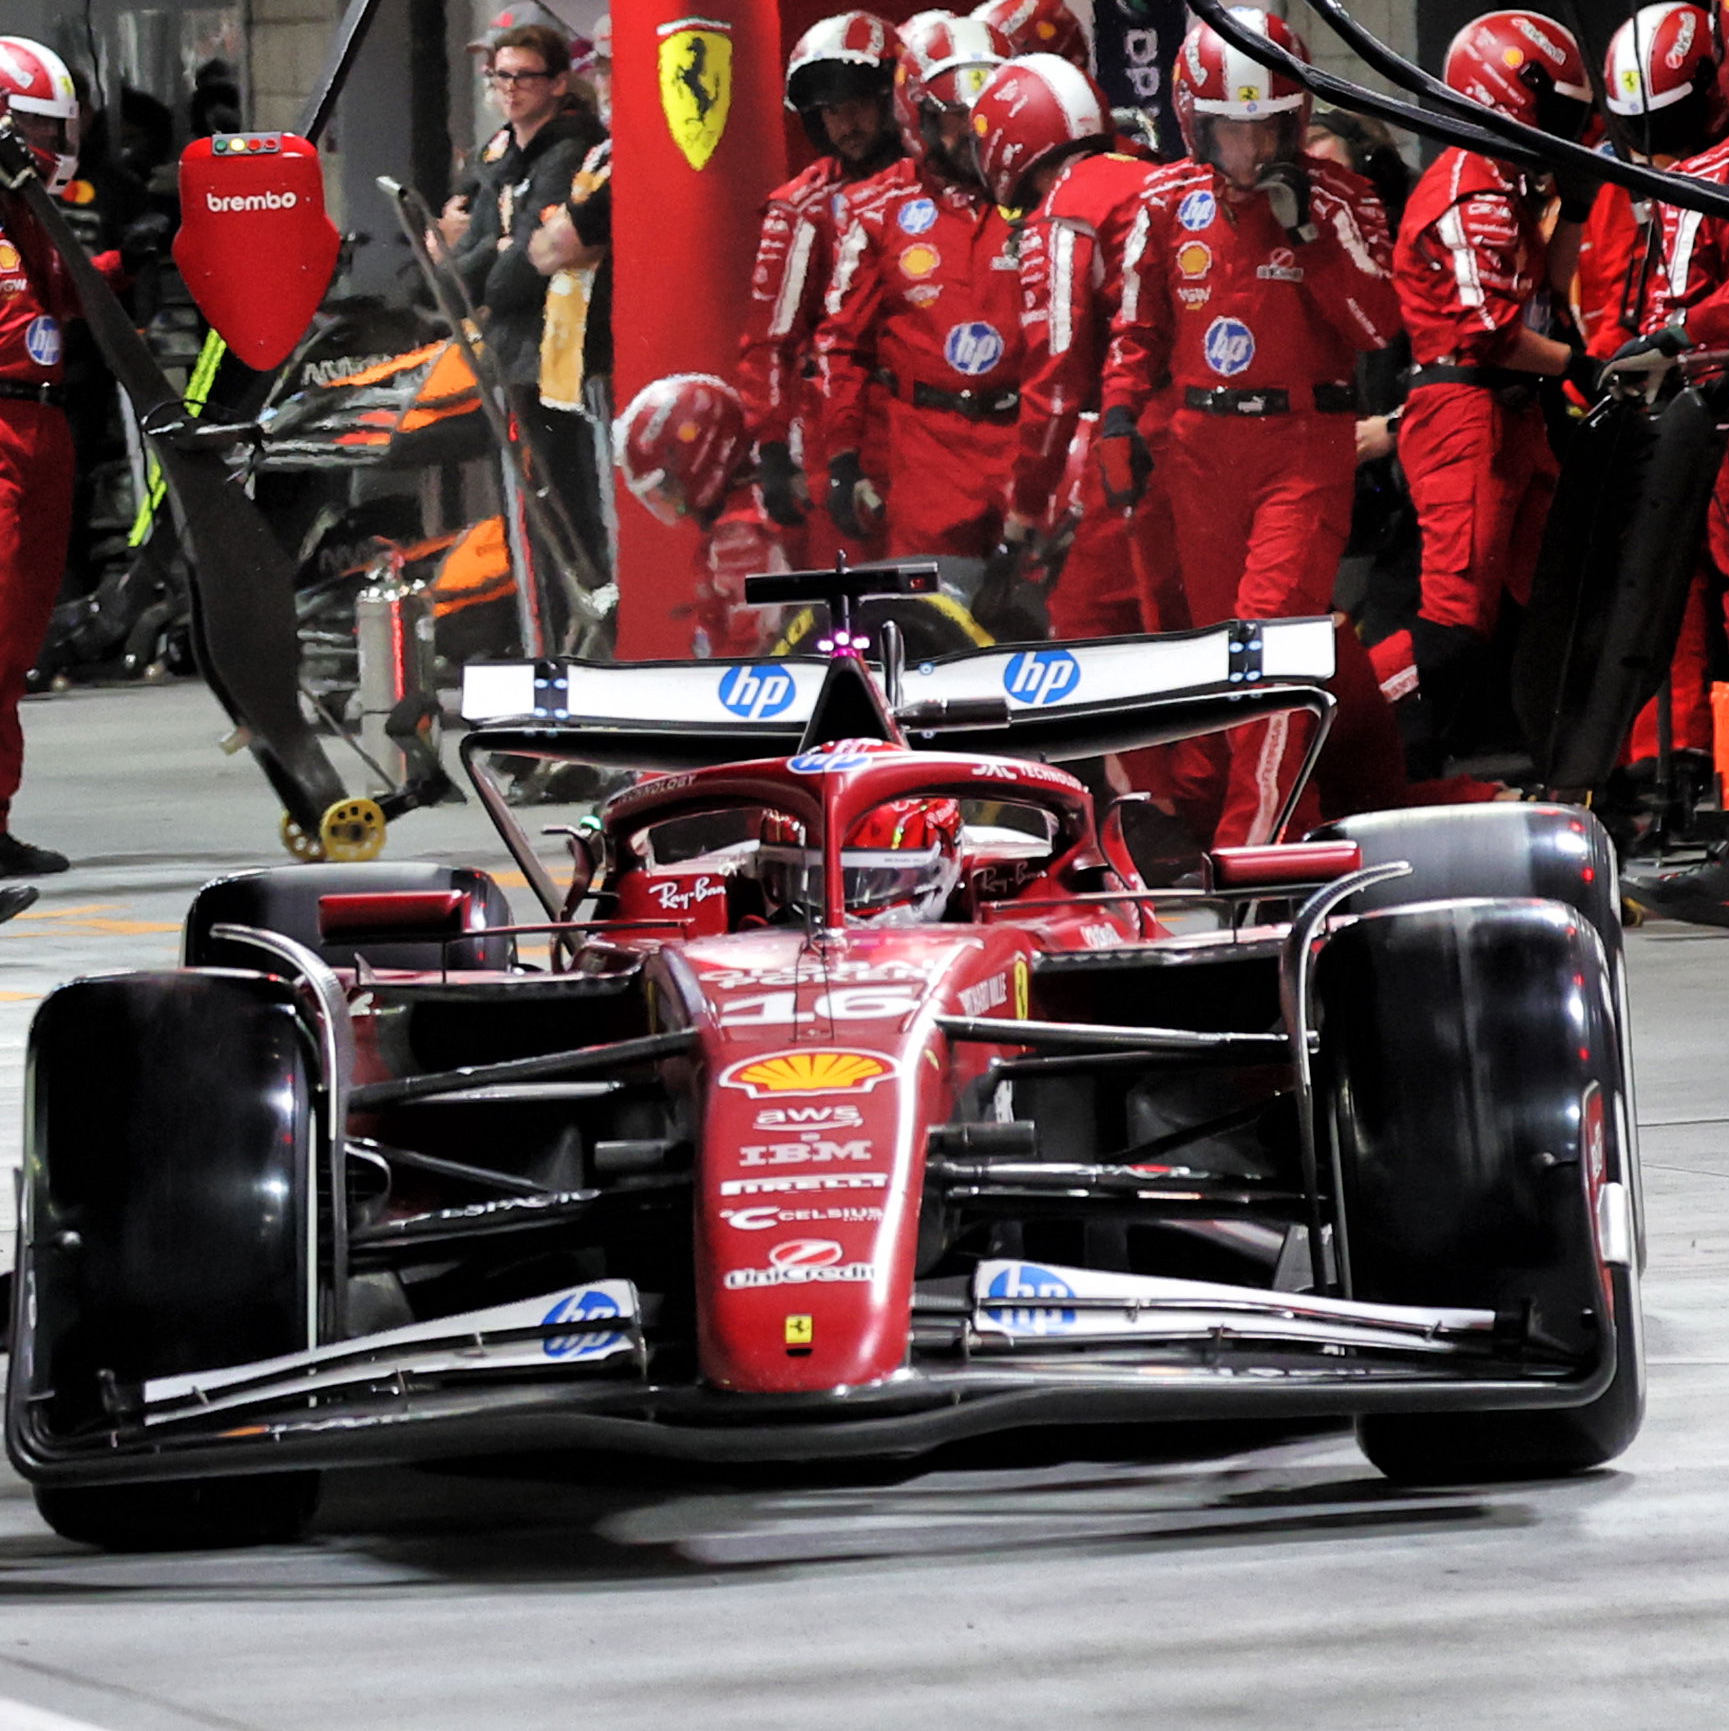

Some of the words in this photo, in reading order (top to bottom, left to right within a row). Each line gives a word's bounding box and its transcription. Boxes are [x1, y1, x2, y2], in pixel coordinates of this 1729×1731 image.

[206, 189, 297, 214] brembo
[948, 324, 1002, 373] hp
[1206, 318, 1253, 374] hp
[726, 666, 790, 719] hp
[1010, 650, 1074, 704] hp
[648, 876, 727, 910] Ray-Ban
[720, 985, 922, 1027] 16
[756, 1105, 861, 1124] aws
[739, 1140, 872, 1167] IBM
[720, 1173, 889, 1196] PIRELLI
[779, 1206, 885, 1221] CELSIUS
[724, 1263, 878, 1289] UniCredit
[1005, 1265, 1066, 1334] hp
